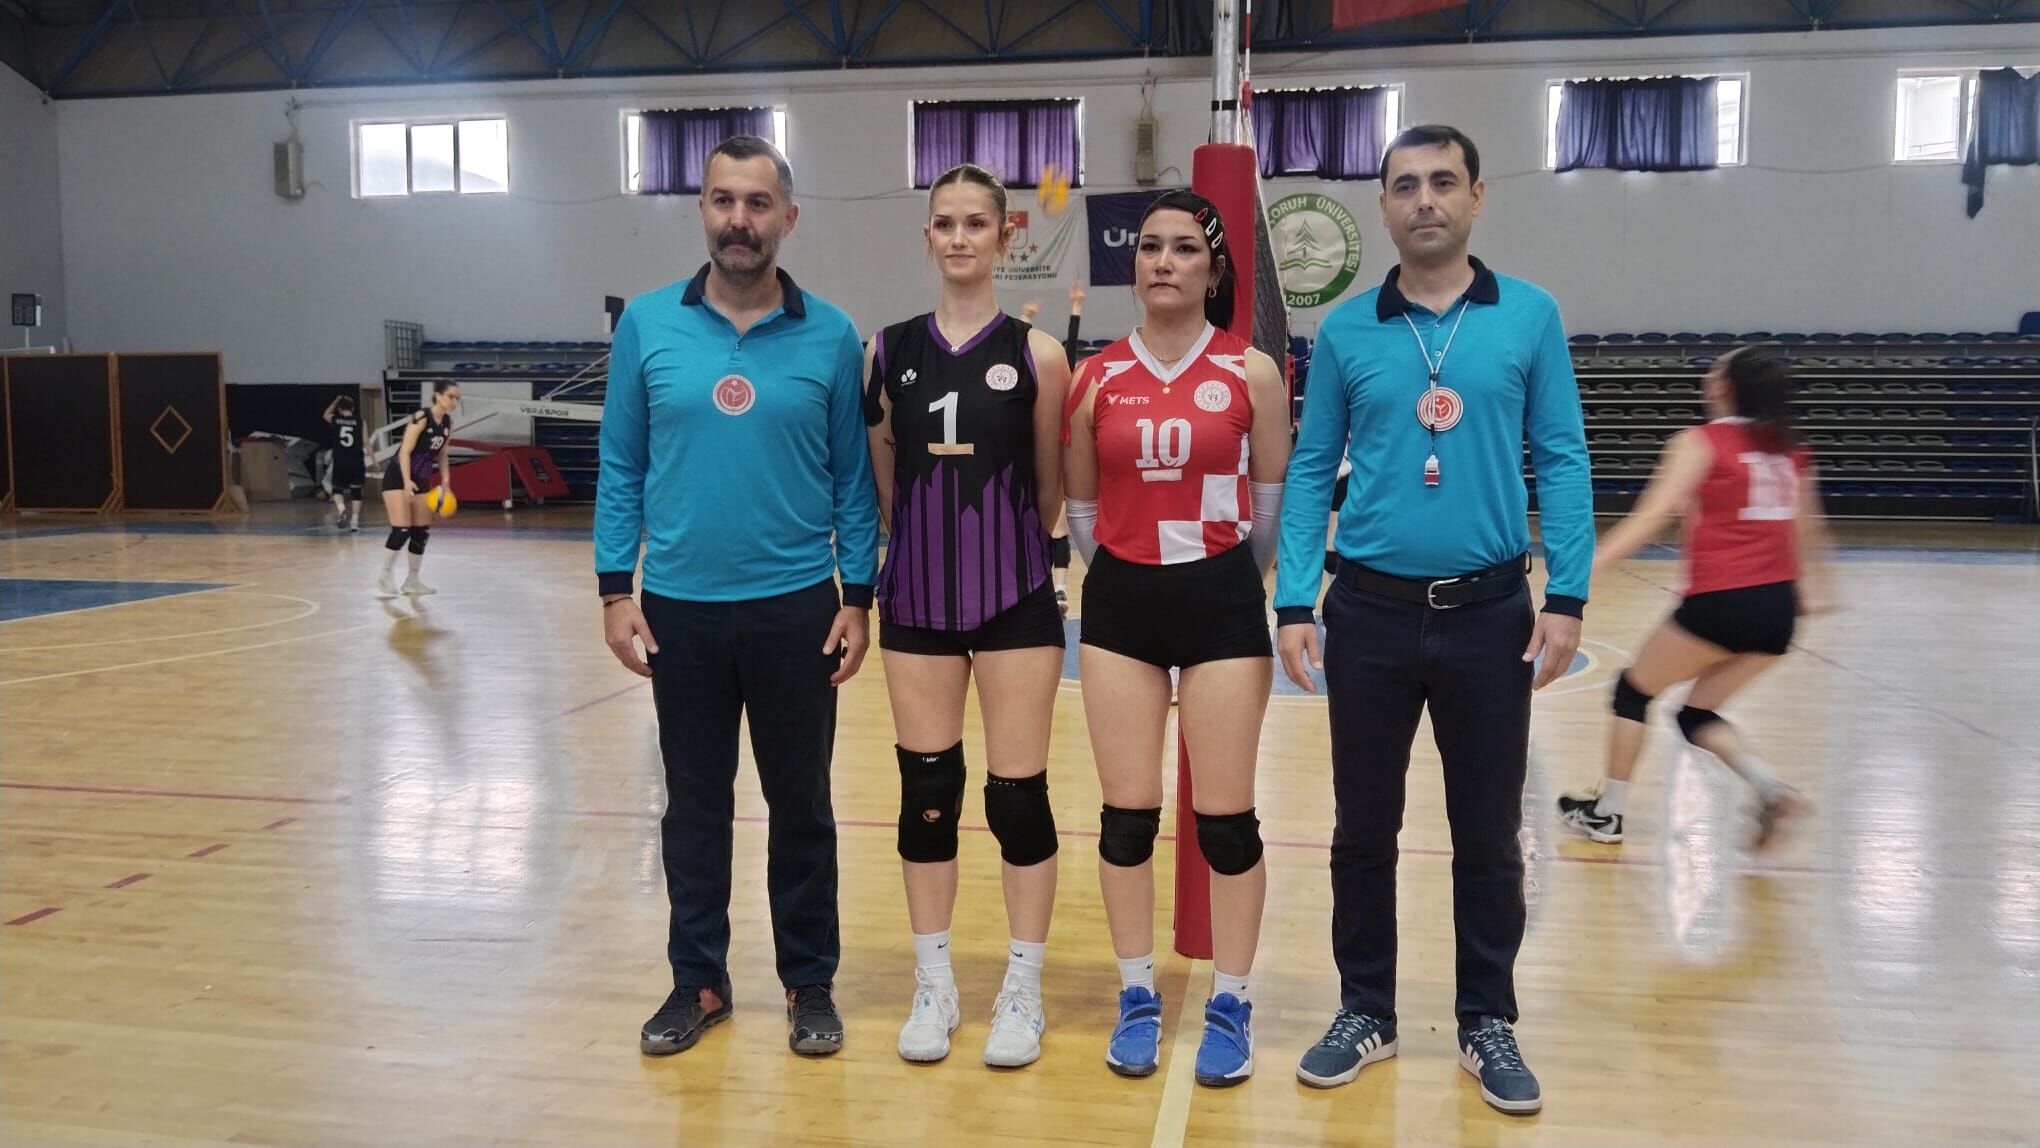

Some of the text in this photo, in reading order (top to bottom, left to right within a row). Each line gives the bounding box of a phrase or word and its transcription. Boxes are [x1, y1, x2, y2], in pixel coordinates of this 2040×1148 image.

[1287, 294, 1321, 306] 2007
[1119, 396, 1150, 405] METS
[520, 407, 569, 417] VERASPOR
[928, 391, 959, 445] 1
[339, 425, 354, 448] 5
[429, 436, 445, 450] 19
[1135, 417, 1192, 469] 10
